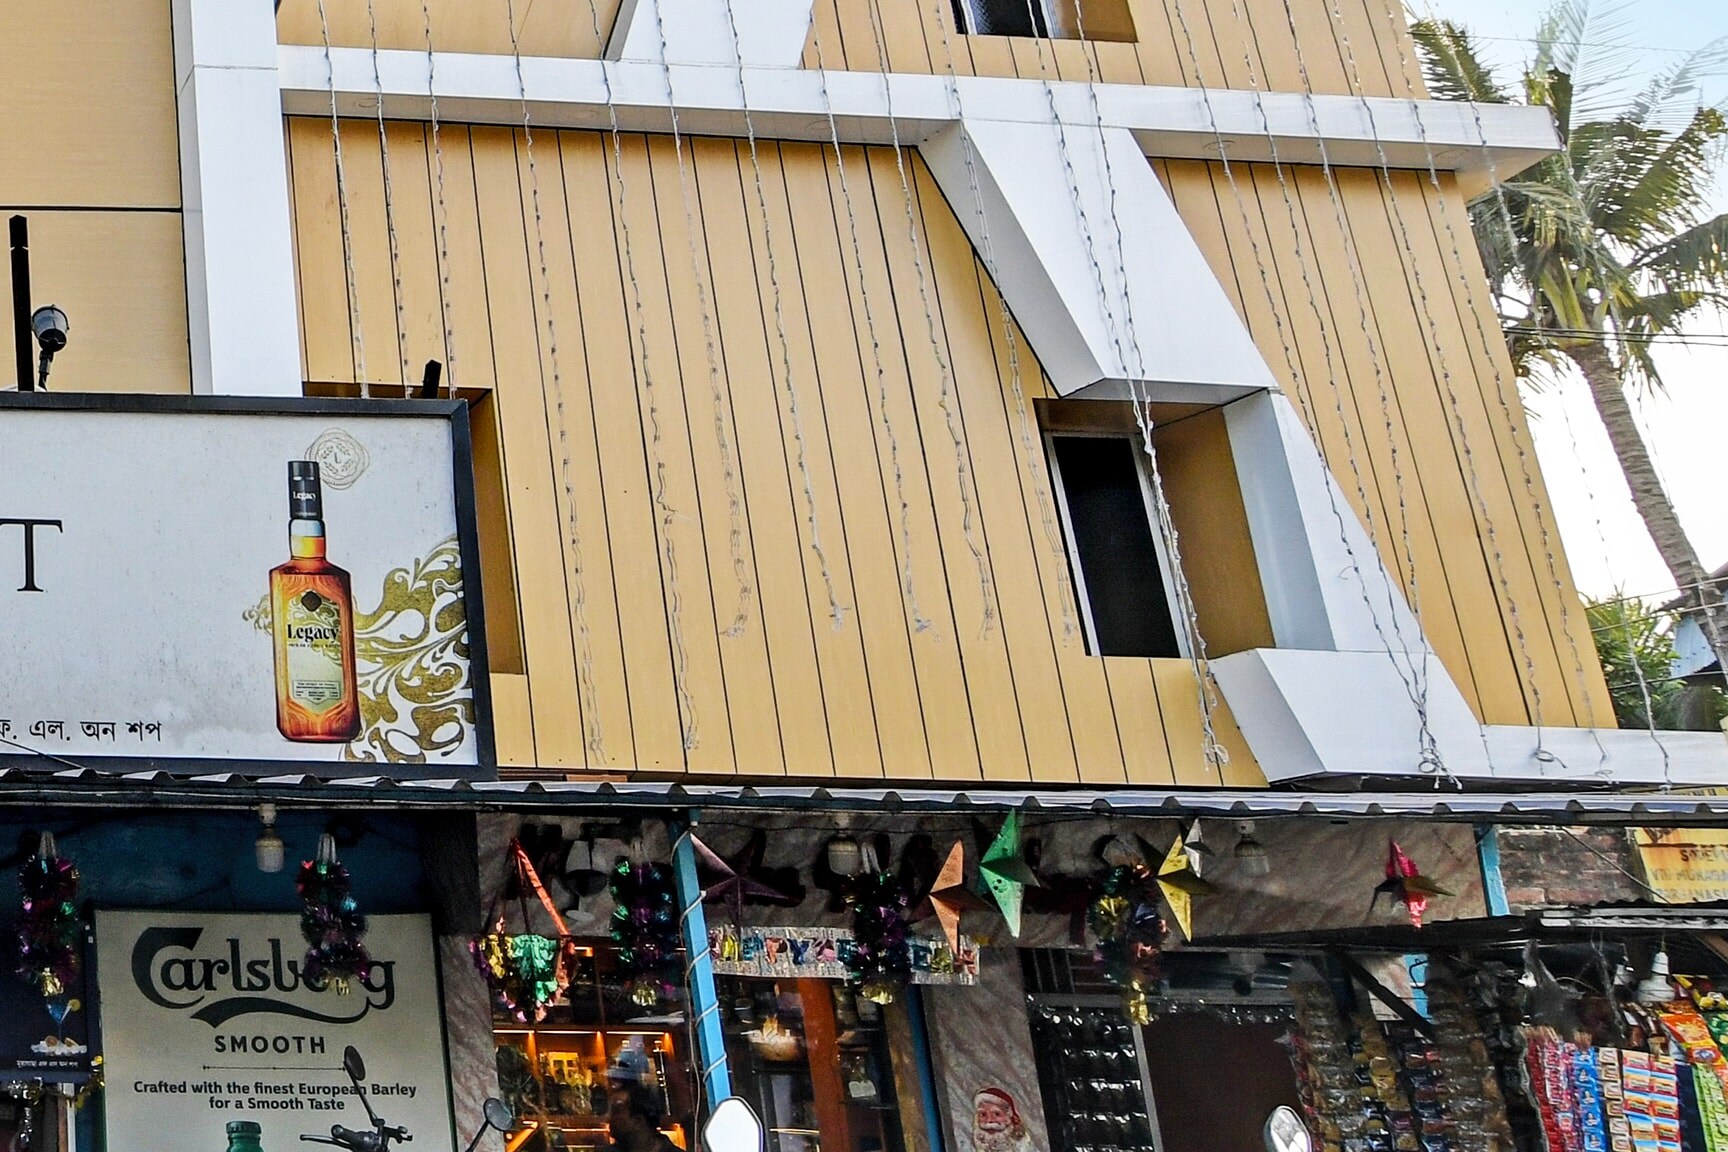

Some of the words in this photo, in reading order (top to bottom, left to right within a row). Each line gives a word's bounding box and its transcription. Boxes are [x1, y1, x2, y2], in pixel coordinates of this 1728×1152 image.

[286, 624, 340, 644] Legacy
[80, 720, 116, 742] অন
[125, 720, 163, 742] শপ
[214, 1035, 326, 1054] SMOOTH
[133, 1080, 187, 1095] Crafted
[191, 1081, 222, 1095] with
[227, 1081, 250, 1095] the
[254, 1081, 294, 1095] finest
[299, 1083, 367, 1098] European
[371, 1083, 417, 1098] Barley
[209, 1097, 230, 1110] for
[235, 1100, 244, 1110] a
[248, 1097, 304, 1110] Smooth
[307, 1098, 345, 1110] Taste
